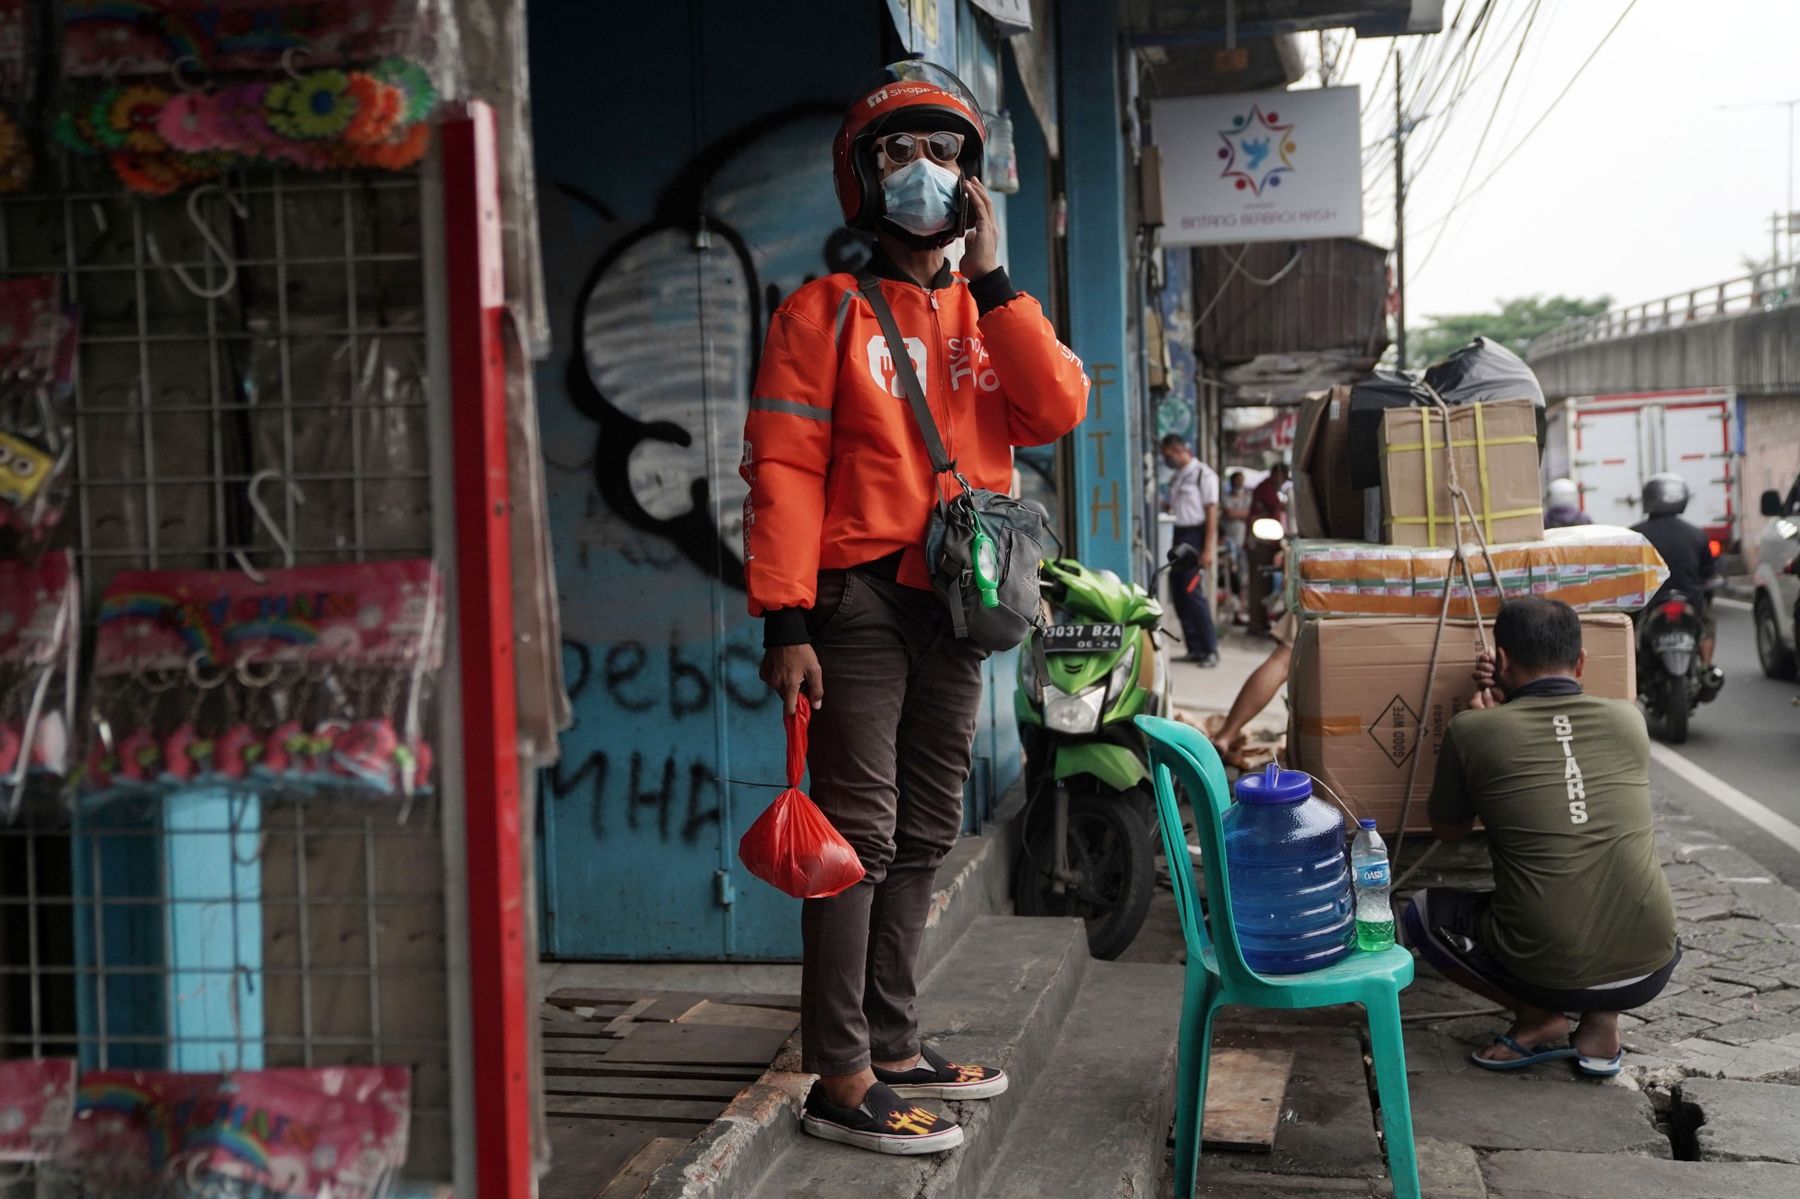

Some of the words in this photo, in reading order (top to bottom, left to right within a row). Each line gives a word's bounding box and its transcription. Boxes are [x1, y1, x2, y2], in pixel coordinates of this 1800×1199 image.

[1092, 624, 1121, 637] BZA
[1392, 706, 1405, 728] WIFE
[1392, 732, 1405, 758] GOOD
[1552, 714, 1588, 824] STARS
